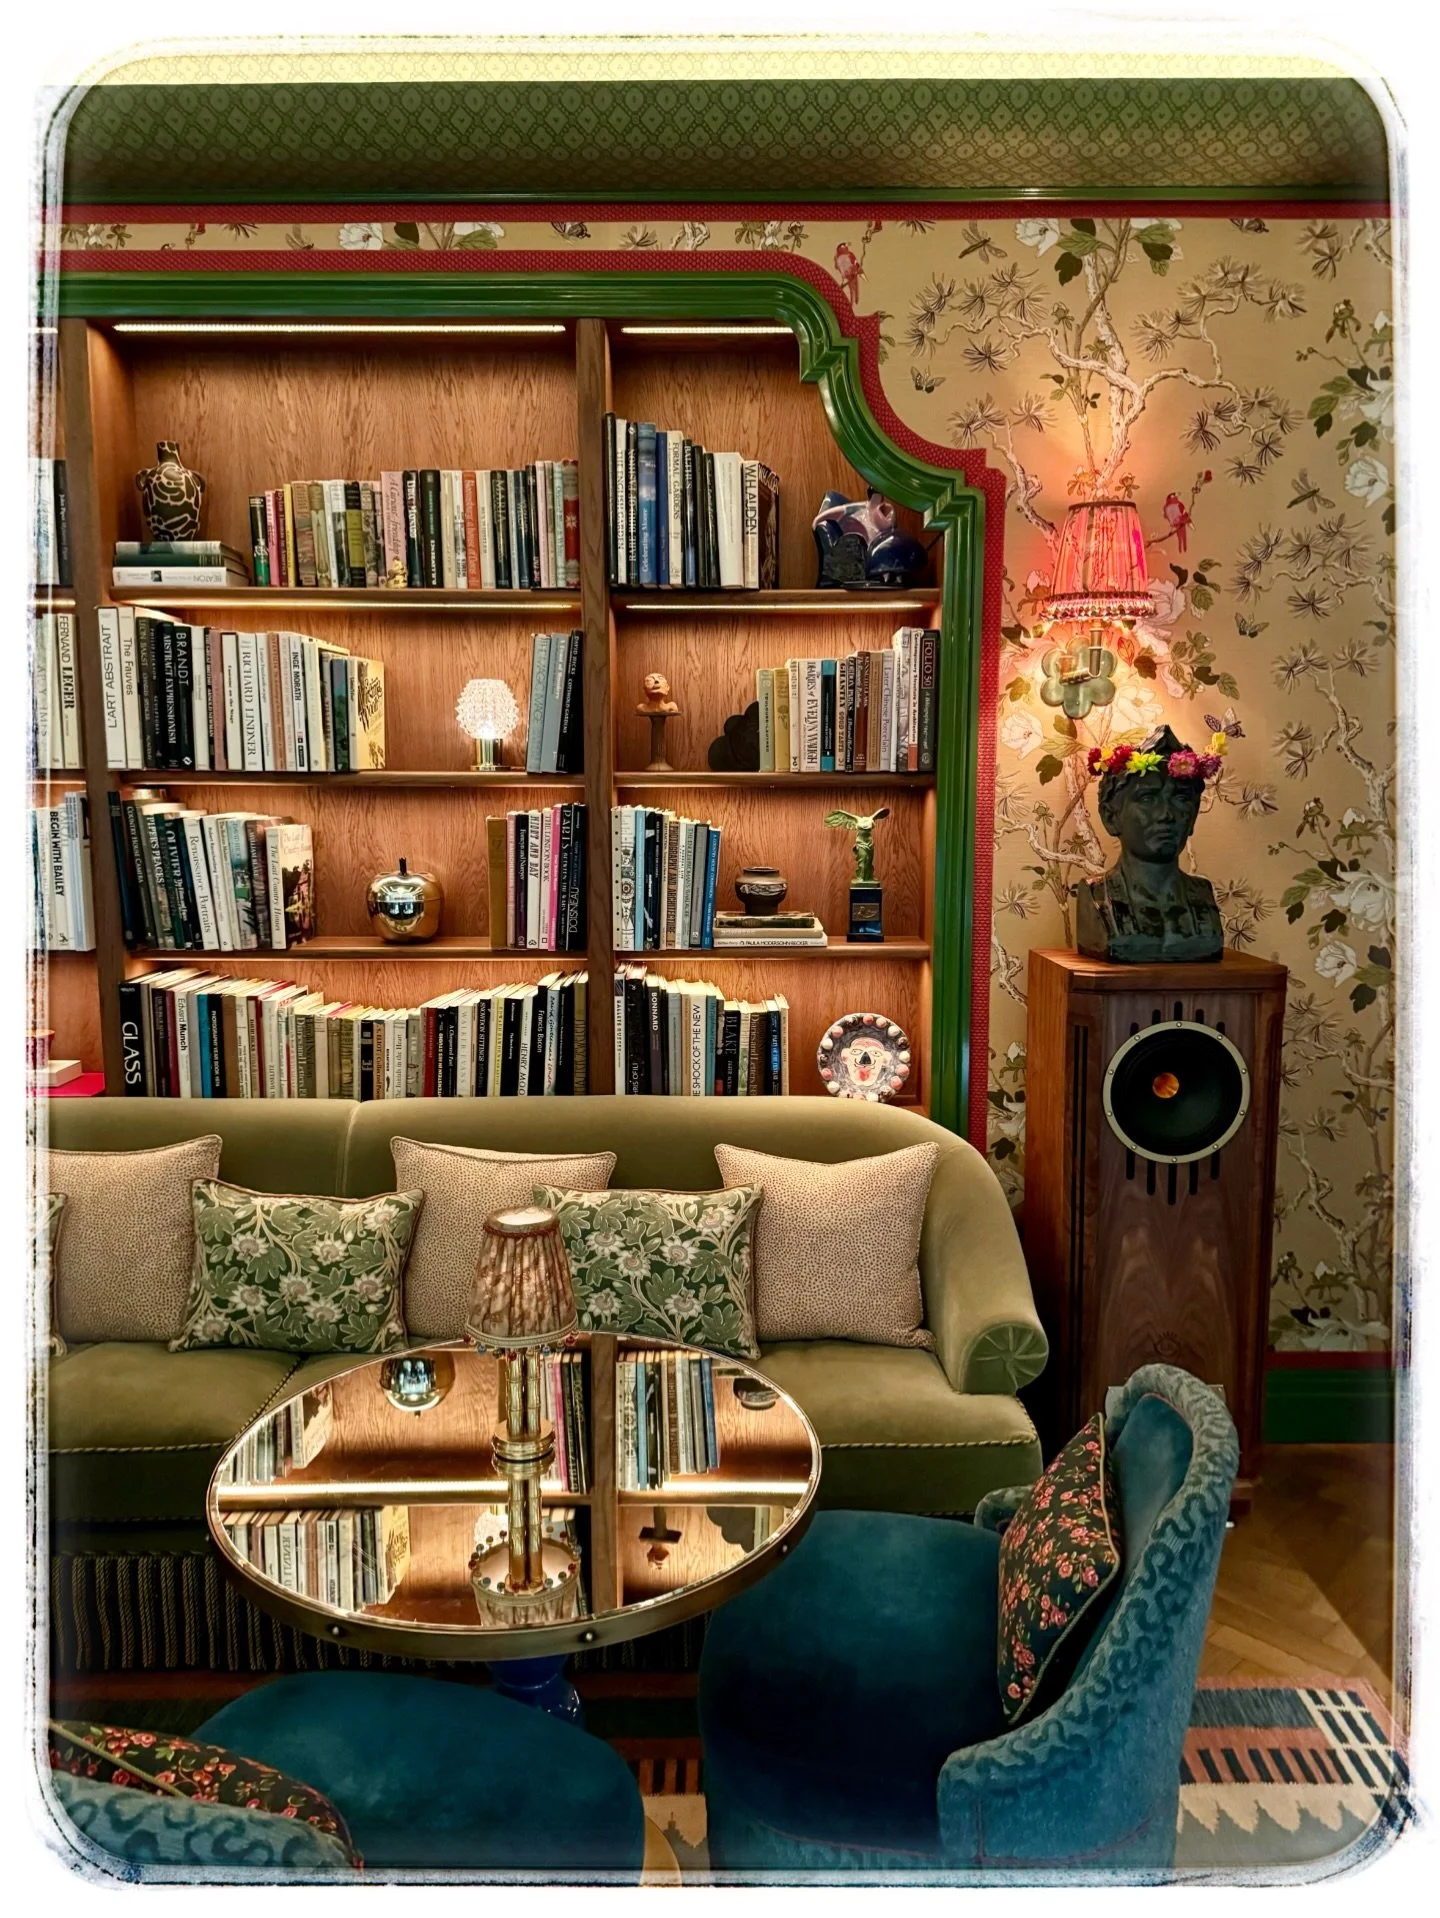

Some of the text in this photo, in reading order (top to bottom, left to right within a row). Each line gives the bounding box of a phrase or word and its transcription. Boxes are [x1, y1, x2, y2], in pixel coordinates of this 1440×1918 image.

[495, 480, 506, 522] MARIA
[672, 442, 681, 520] FORMAL GARDENS
[641, 532, 649, 572] Celebrating
[60, 616, 75, 709] FERNAND LEGER
[101, 624, 117, 728] L'ART ABSTRAIT
[124, 638, 134, 696] The Fauves
[176, 632, 189, 686] BRANDT
[292, 651, 302, 701] INGE MORATH
[925, 641, 933, 674] FOLIO
[163, 634, 176, 744] ABSTRACT EXPRESSIONISM
[924, 676, 932, 686] 50
[242, 651, 256, 756] RICHARD LINDNER
[805, 699, 818, 732] EVELYN
[882, 667, 892, 753] Later Chinese Porcelain
[807, 733, 818, 764] WAUGH
[562, 809, 571, 850] PARIS
[50, 811, 64, 896] BEGIN WITH BAILEY
[134, 859, 144, 883] CAMERA
[152, 851, 165, 883] PLACES
[166, 830, 181, 876] OLIVIER
[270, 845, 278, 858] The
[530, 862, 539, 878] DAY
[190, 835, 212, 933] Renaissance Portraits
[271, 877, 281, 906] Country
[668, 825, 679, 934] PHOTOGRAPHY AND ARCHITECTURE
[274, 908, 282, 931] Houses
[569, 886, 580, 933] DOISNEAU
[178, 998, 188, 1051] Edvard Munch
[692, 1004, 701, 1027] NEW
[693, 1028, 701, 1044] THE
[725, 1016, 737, 1055] BLAKE
[122, 1021, 142, 1084] GLASS
[296, 1017, 307, 1088] Diaries and Letters
[520, 1043, 528, 1069] HENRY
[693, 1046, 701, 1058] OF
[750, 1014, 760, 1083] Diaries and Letters
[693, 1058, 701, 1089] SHOCK
